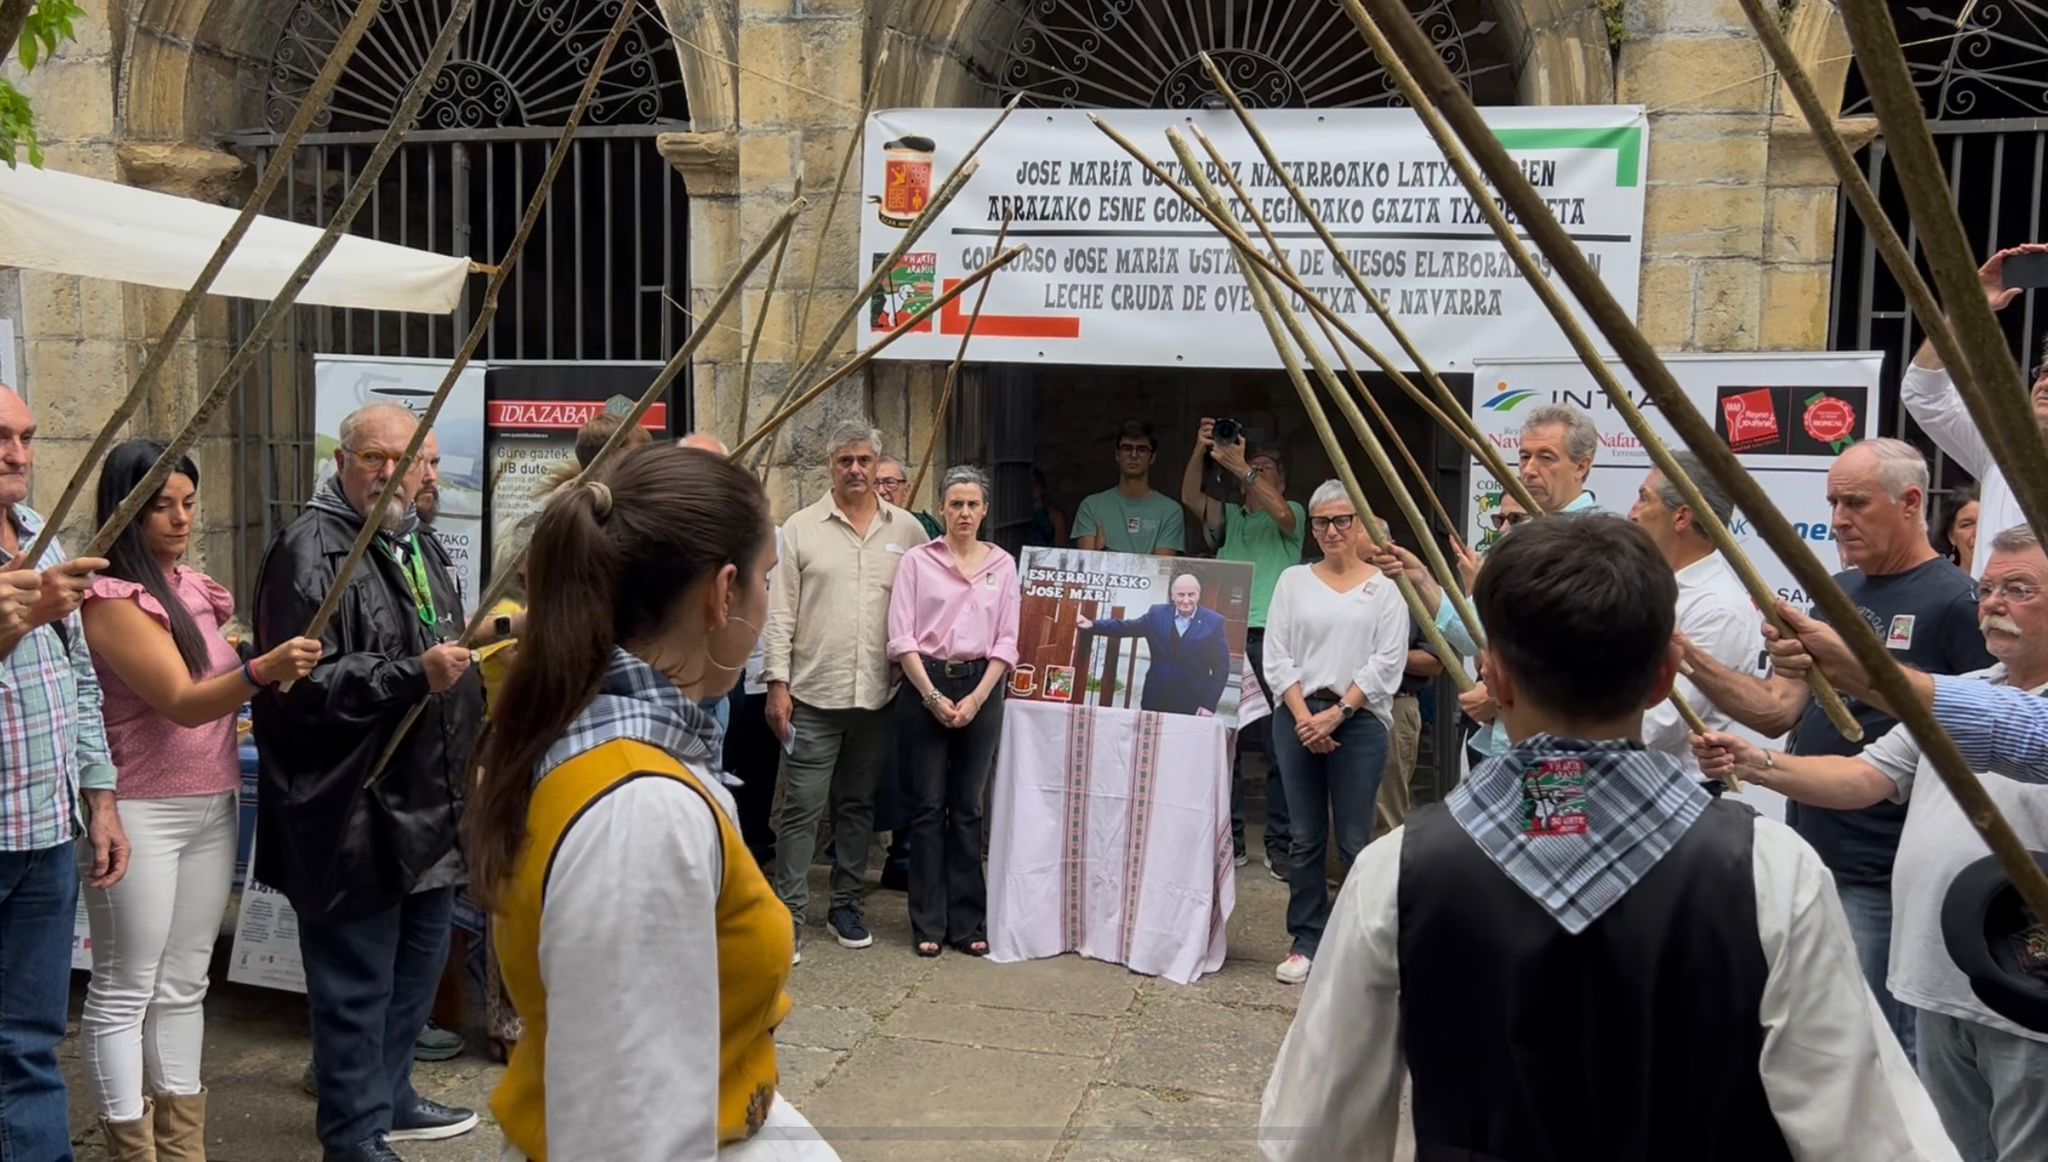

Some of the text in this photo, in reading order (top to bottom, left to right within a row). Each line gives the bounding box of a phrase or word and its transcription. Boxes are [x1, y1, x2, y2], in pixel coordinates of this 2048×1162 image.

[1016, 160, 1062, 186] JOSE
[1142, 161, 1242, 187] USTAROZ
[1398, 161, 1463, 188] LATX
[1098, 196, 1146, 222] ESNE
[1372, 197, 1441, 224] GAZTA
[1064, 247, 1108, 273] JOSE
[1299, 249, 1325, 276] DE
[1044, 283, 1104, 309] LECHE
[1111, 284, 1174, 311] CRUDA
[1182, 285, 1207, 311] DE
[1214, 285, 1274, 313] OVE
[1400, 288, 1503, 316] NAVARRA
[497, 446, 526, 459] Gure
[497, 462, 516, 474] JIB
[1028, 569, 1151, 590] ESKERRIK ASKO
[1026, 585, 1110, 602] JOSE MARI
